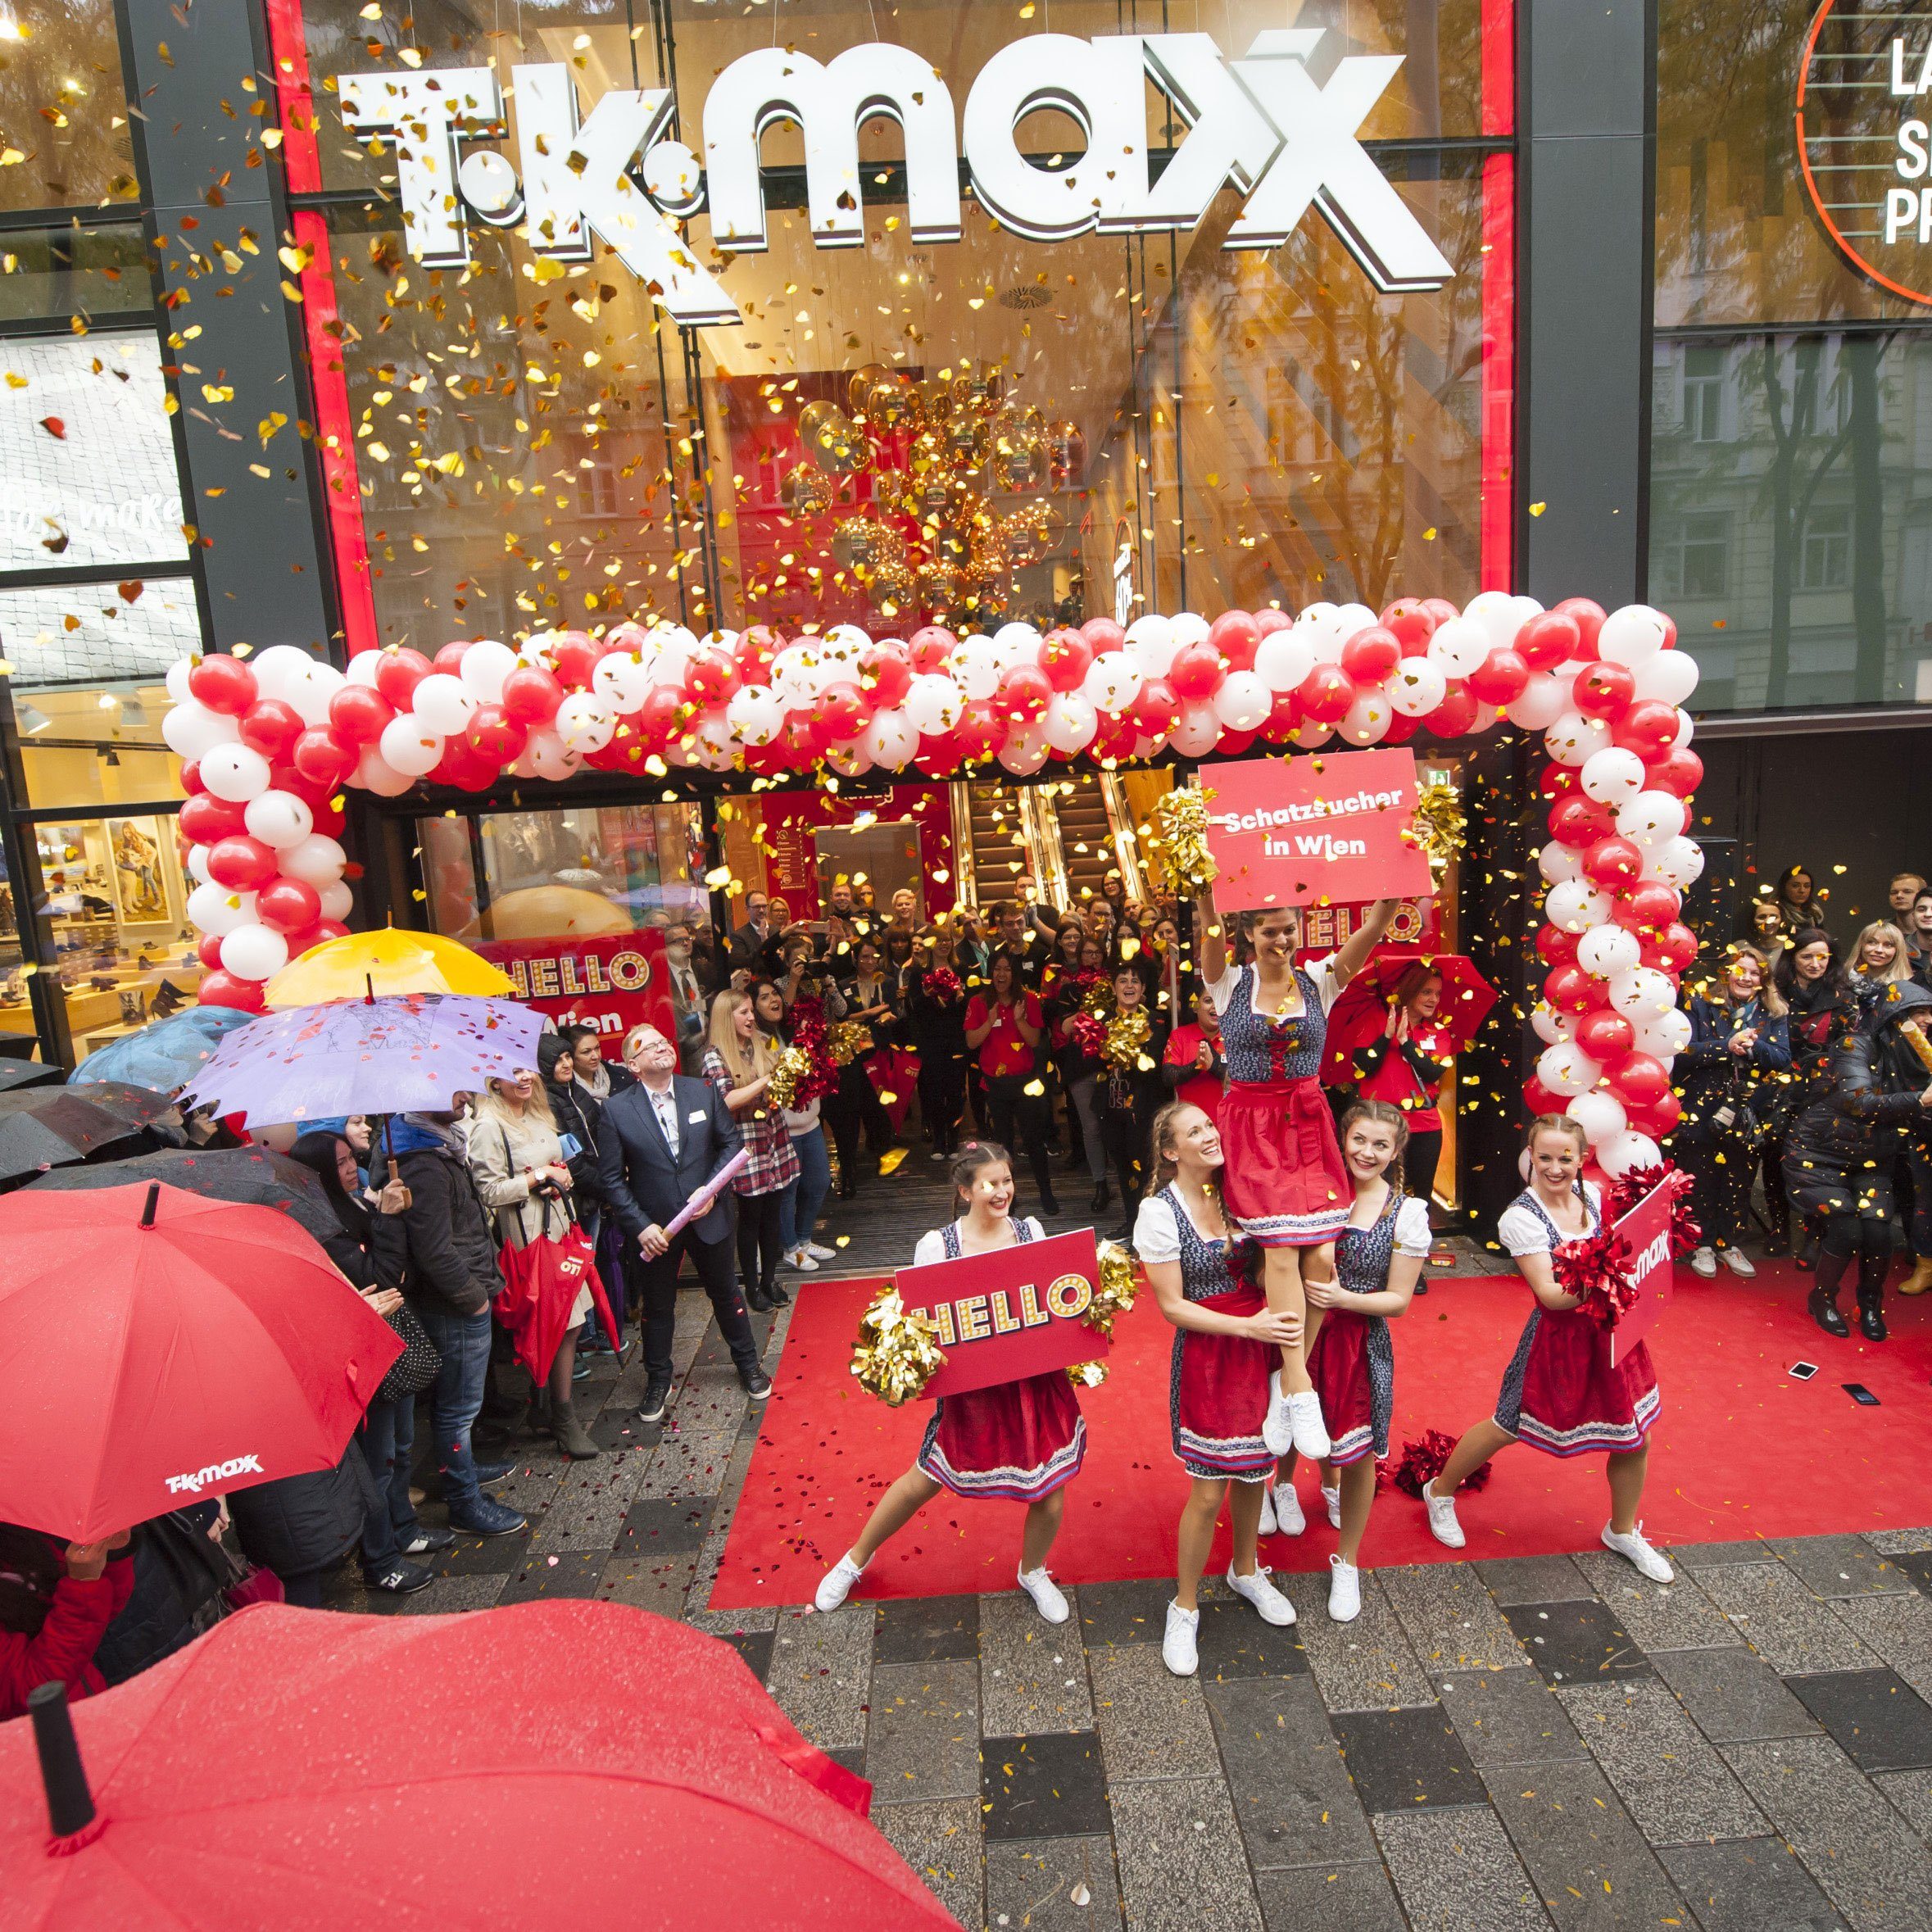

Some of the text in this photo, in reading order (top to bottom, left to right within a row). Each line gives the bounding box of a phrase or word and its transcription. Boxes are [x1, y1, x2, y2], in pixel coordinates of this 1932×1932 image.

[1224, 788, 1404, 833] Schatzsucher
[1264, 833, 1366, 856] in Wien
[1296, 903, 1422, 949] ELO
[492, 950, 651, 1000] HELLO
[910, 1273, 1093, 1346] HELLO
